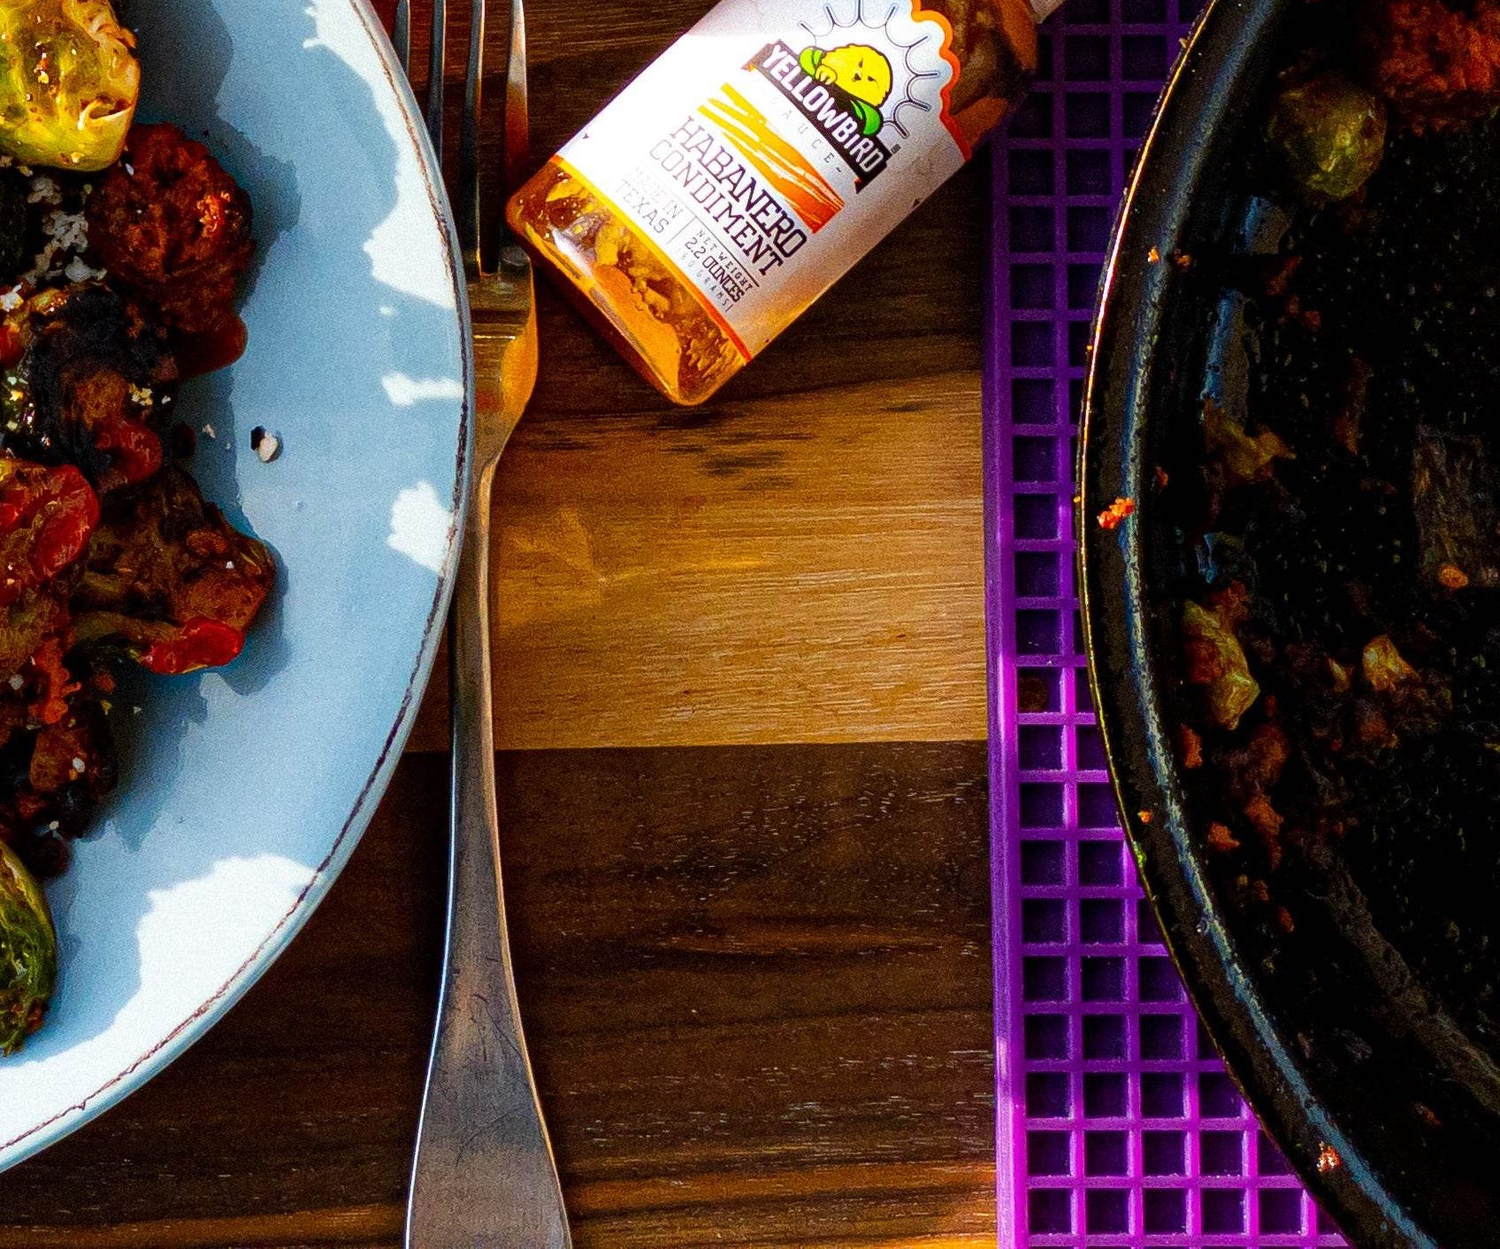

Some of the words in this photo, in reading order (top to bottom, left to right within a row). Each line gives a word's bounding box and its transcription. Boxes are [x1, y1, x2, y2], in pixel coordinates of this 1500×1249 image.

[762, 44, 885, 173] YELLOWBIRD
[613, 177, 669, 234] TEXAS
[649, 139, 784, 276] CONDIMENT
[662, 199, 684, 220] IN
[669, 116, 807, 258] HABANERO
[684, 237, 706, 260] 2.2
[702, 254, 745, 303] OUNCES
[696, 229, 718, 252] NET
[718, 252, 754, 292] WEIGHT
